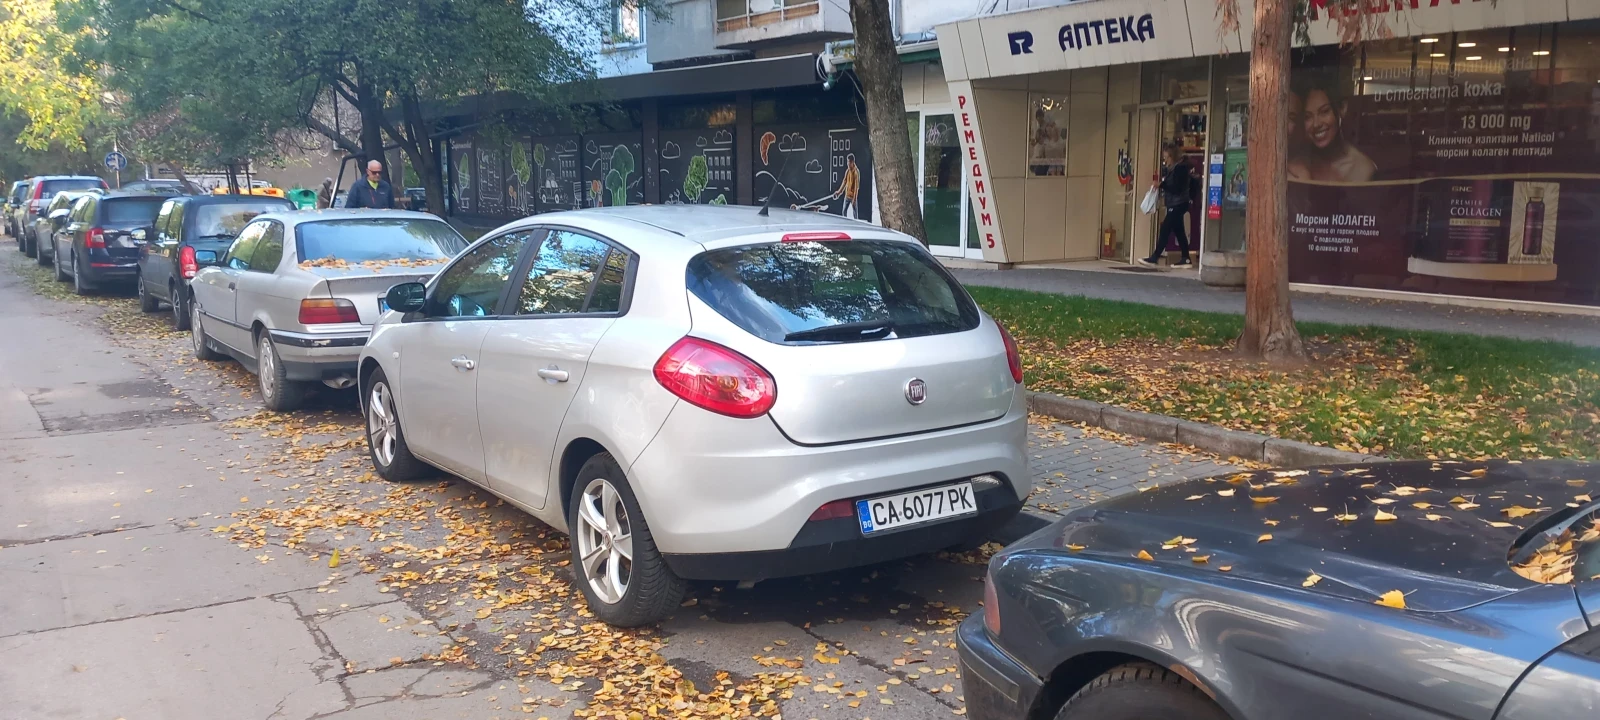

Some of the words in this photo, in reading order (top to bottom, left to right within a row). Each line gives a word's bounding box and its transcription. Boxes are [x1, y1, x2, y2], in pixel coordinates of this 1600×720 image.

[1058, 13, 1155, 52] АПТЕКА
[1433, 56, 1533, 78] хидратирана
[1374, 90, 1382, 102] и
[1386, 86, 1459, 102] стегната
[1463, 80, 1502, 97] кожа
[1461, 115, 1476, 129] 13
[1481, 114, 1504, 128] 000
[1510, 116, 1531, 130] mg
[1428, 136, 1472, 146] Клинично
[1476, 134, 1518, 144] изпитани
[1522, 132, 1555, 143] Naticol
[1436, 148, 1469, 159] морски
[1472, 148, 1509, 157] колаген
[1512, 146, 1553, 156] пептиди
[957, 95, 994, 227] РЕМЕДИУМ
[985, 232, 996, 249] 5
[1296, 213, 1328, 226] Морски
[1332, 214, 1376, 227] КОЛАГЕН
[1450, 206, 1502, 217] COLLAGEN
[872, 500, 900, 526] CA
[902, 492, 944, 520] 6077
[948, 486, 973, 512] PK
